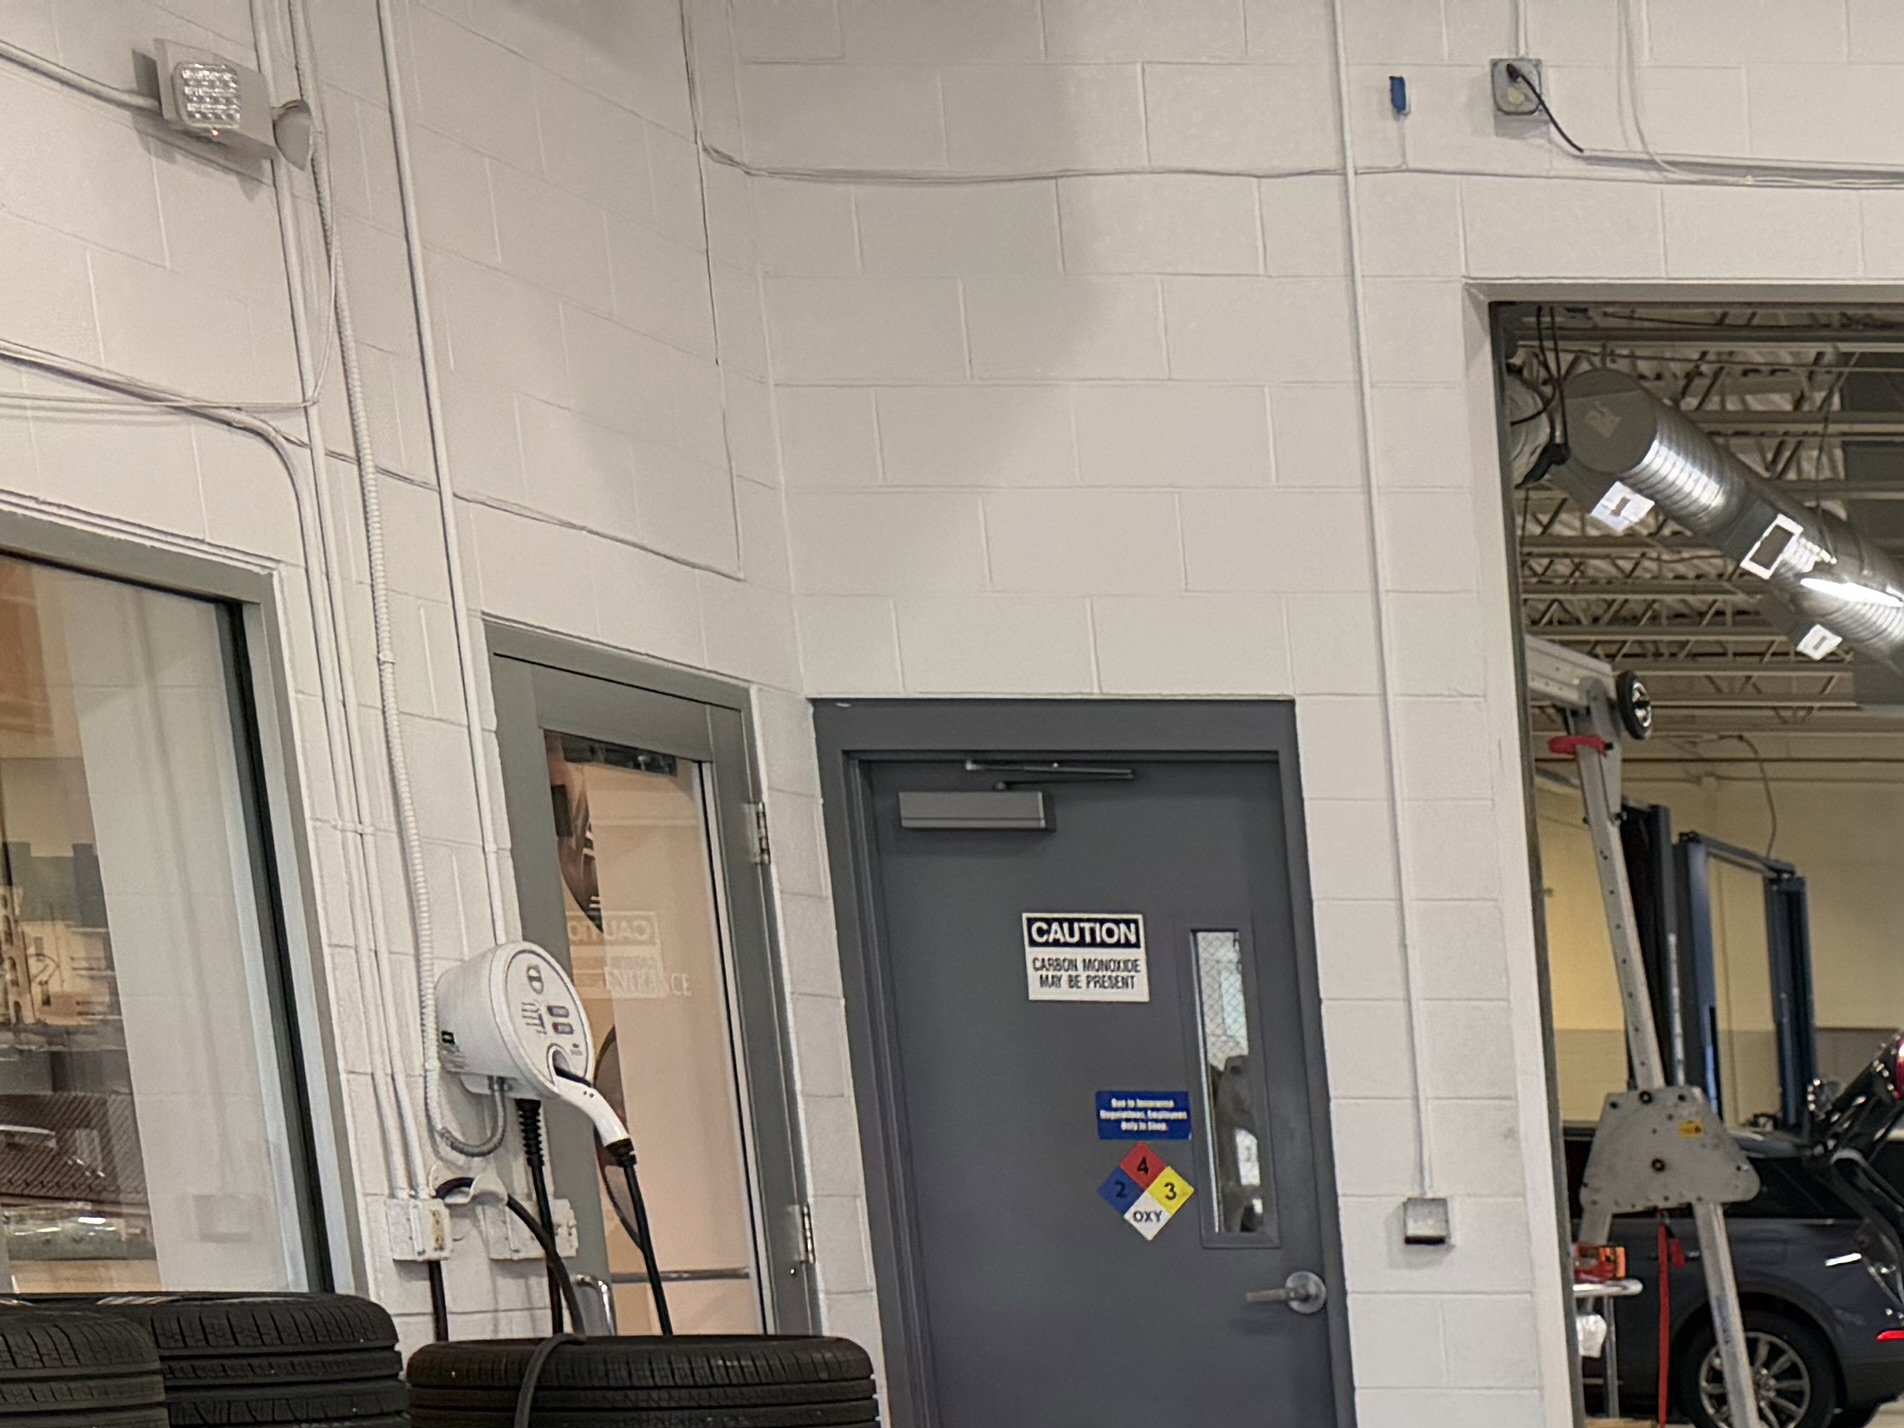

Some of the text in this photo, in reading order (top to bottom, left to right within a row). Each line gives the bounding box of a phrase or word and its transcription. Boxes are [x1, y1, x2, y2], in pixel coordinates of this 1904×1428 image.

[1031, 921, 1138, 944] CAUTION
[1032, 957, 1141, 973] CARBON MONOXIDE
[1039, 974, 1136, 990] MAY BE PRESENT
[1137, 1156, 1149, 1175] 4
[1114, 1180, 1177, 1201] 2 3
[1132, 1209, 1163, 1223] OXY
